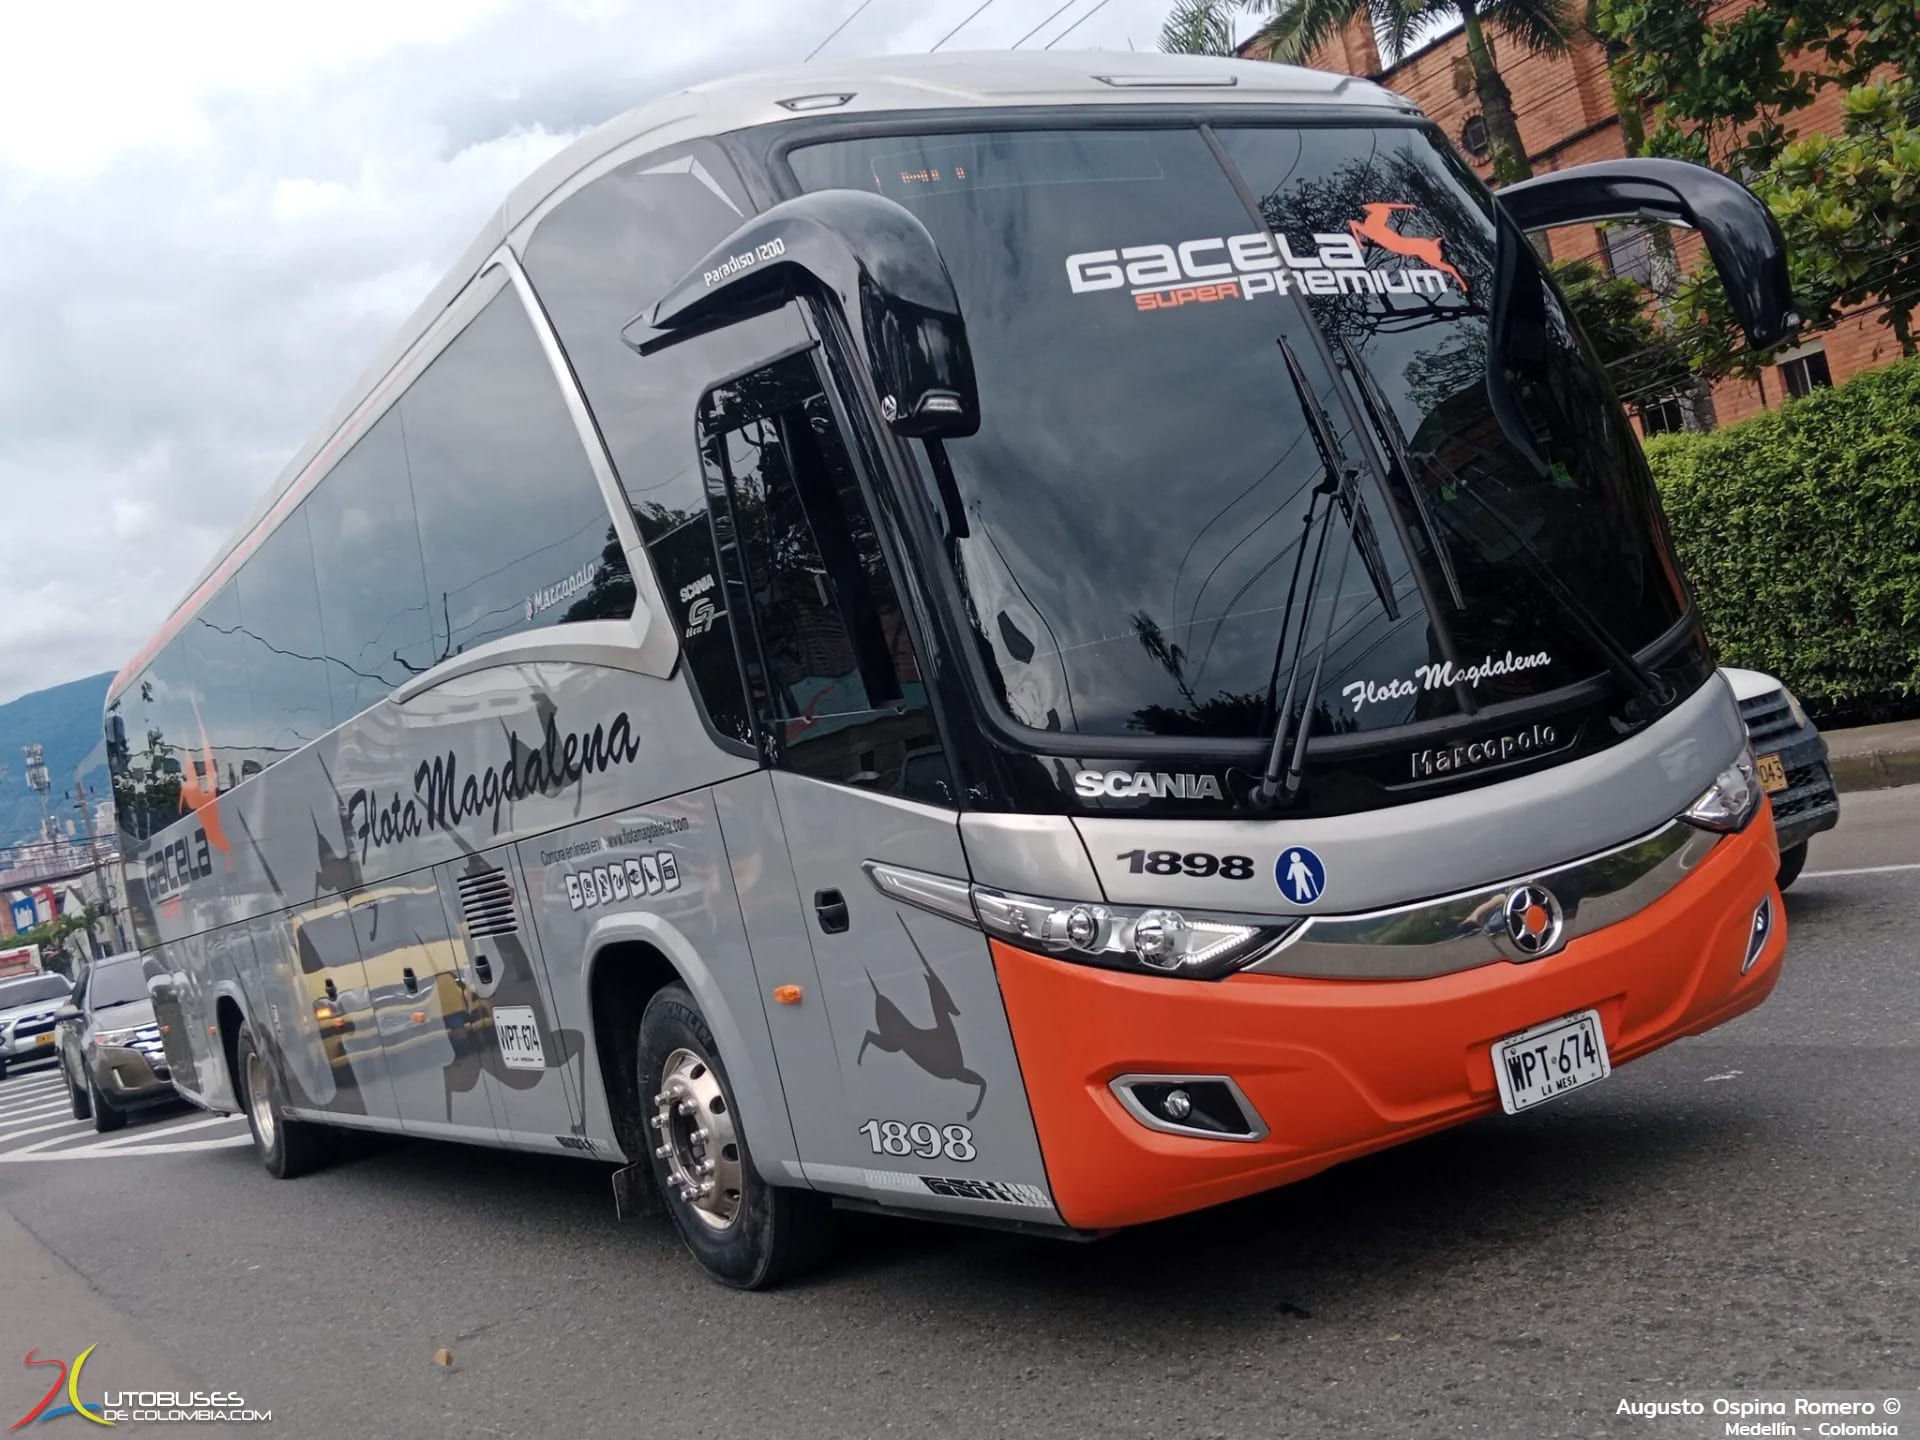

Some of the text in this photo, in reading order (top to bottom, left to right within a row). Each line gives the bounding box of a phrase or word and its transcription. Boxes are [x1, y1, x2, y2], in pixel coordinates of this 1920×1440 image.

[704, 238, 786, 287] Paradiso 1200
[1136, 268, 1448, 312] SUPER PREMIUM
[534, 563, 595, 613] Marcopolo
[679, 573, 716, 603] SCANIA
[1342, 650, 1552, 713] Flota Magdalena
[1411, 724, 1556, 779] Marcopolo
[350, 712, 640, 865] Flota Magdalena
[1074, 770, 1224, 800] SCANIA
[1116, 849, 1255, 881] 1898
[1541, 1075, 1578, 1096] LA MESA
[858, 1118, 978, 1163] 1898
